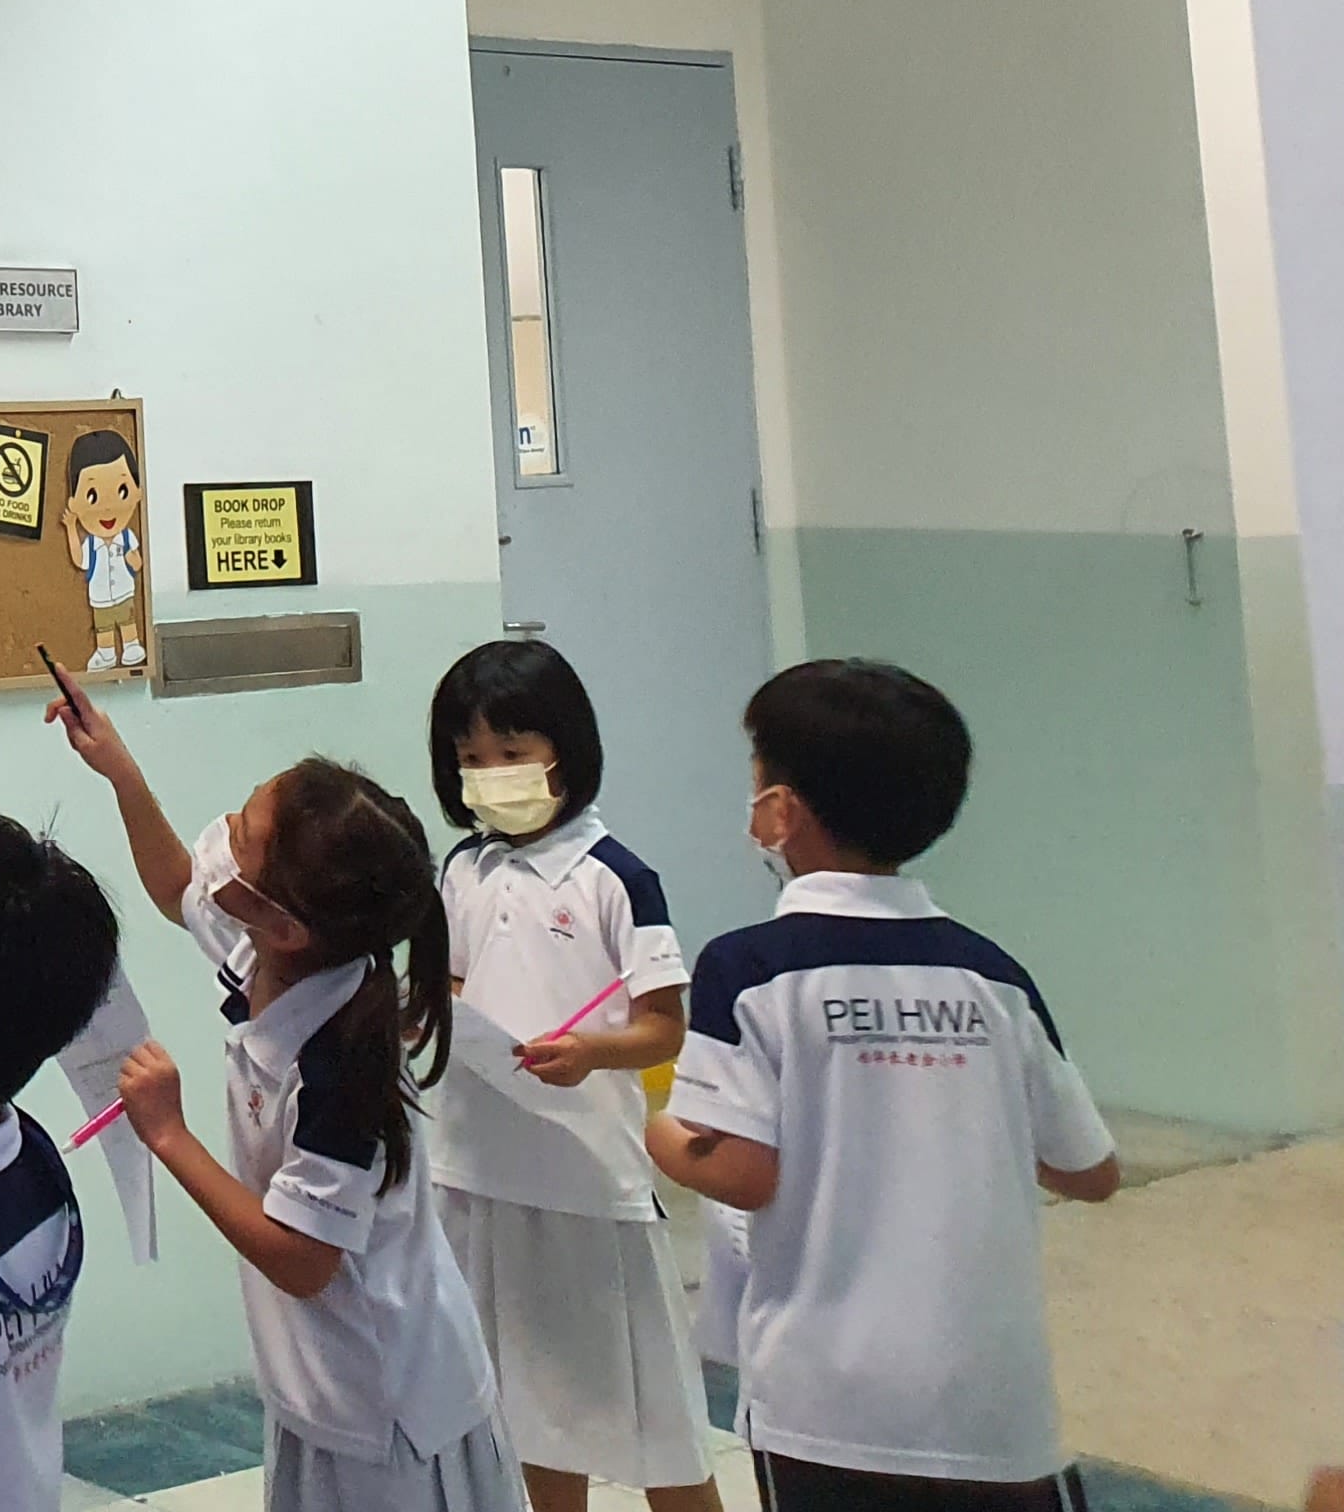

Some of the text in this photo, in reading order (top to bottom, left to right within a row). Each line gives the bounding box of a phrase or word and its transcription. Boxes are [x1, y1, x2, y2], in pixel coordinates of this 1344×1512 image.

[0, 282, 73, 298] RESOURCE
[7, 500, 30, 513] FOOD
[214, 497, 286, 513] BOOK DROP
[2, 510, 32, 523] DRINKS
[220, 517, 281, 529] Please return
[211, 532, 292, 549] your library books
[216, 549, 270, 572] HERE
[823, 998, 991, 1034] PEI HWA
